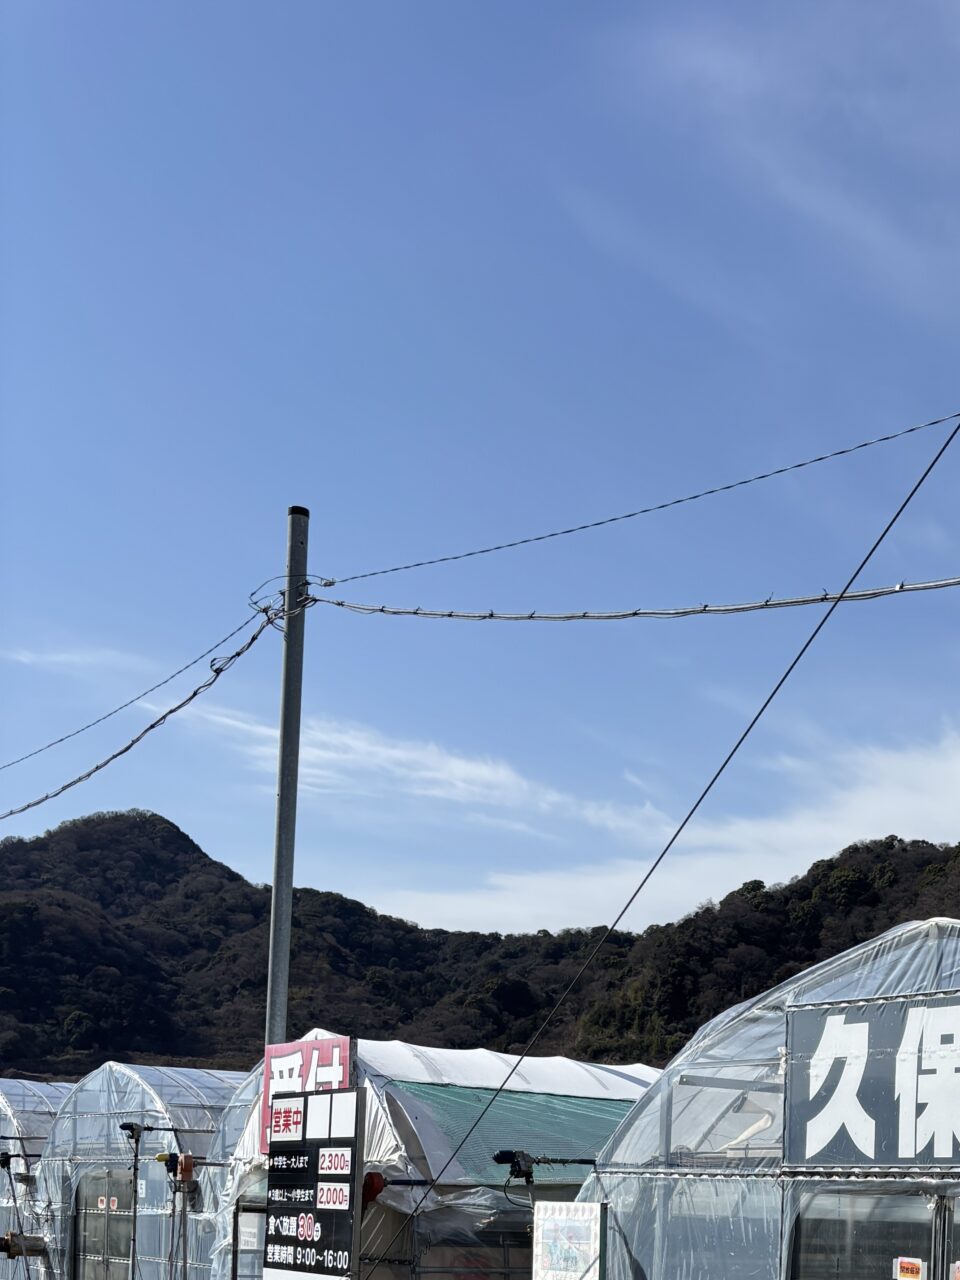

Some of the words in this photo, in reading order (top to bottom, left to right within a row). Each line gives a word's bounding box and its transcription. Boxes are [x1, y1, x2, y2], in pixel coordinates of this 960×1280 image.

[272, 1106, 302, 1134] 営業中
[320, 1153, 350, 1171] 2,300円
[318, 1187, 349, 1206] 2,000円
[266, 1244, 295, 1265] 営業時間
